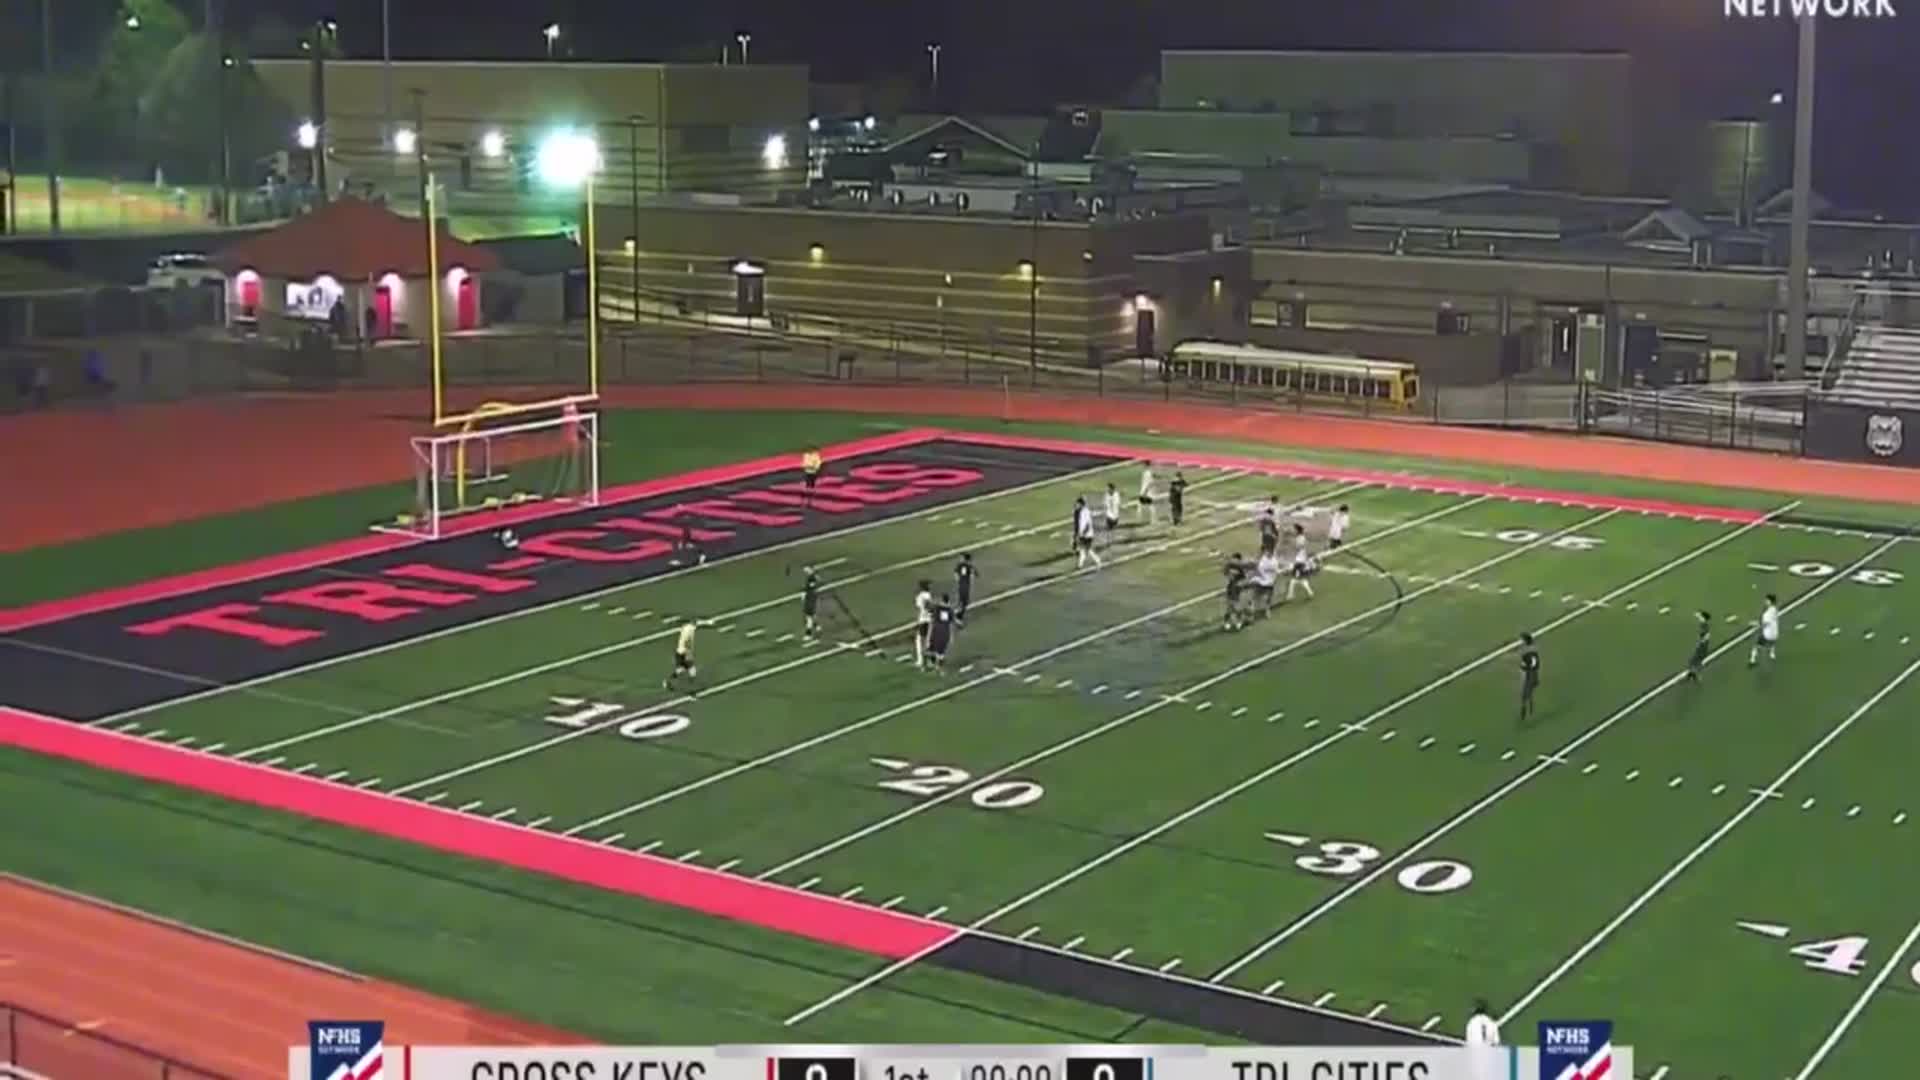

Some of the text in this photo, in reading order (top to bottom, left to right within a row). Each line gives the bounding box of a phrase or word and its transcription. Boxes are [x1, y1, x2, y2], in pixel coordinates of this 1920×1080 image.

[125, 462, 985, 646] TRI-CITIES
[544, 702, 691, 738] 10
[876, 765, 1044, 808] 20
[1295, 841, 1473, 892] 30
